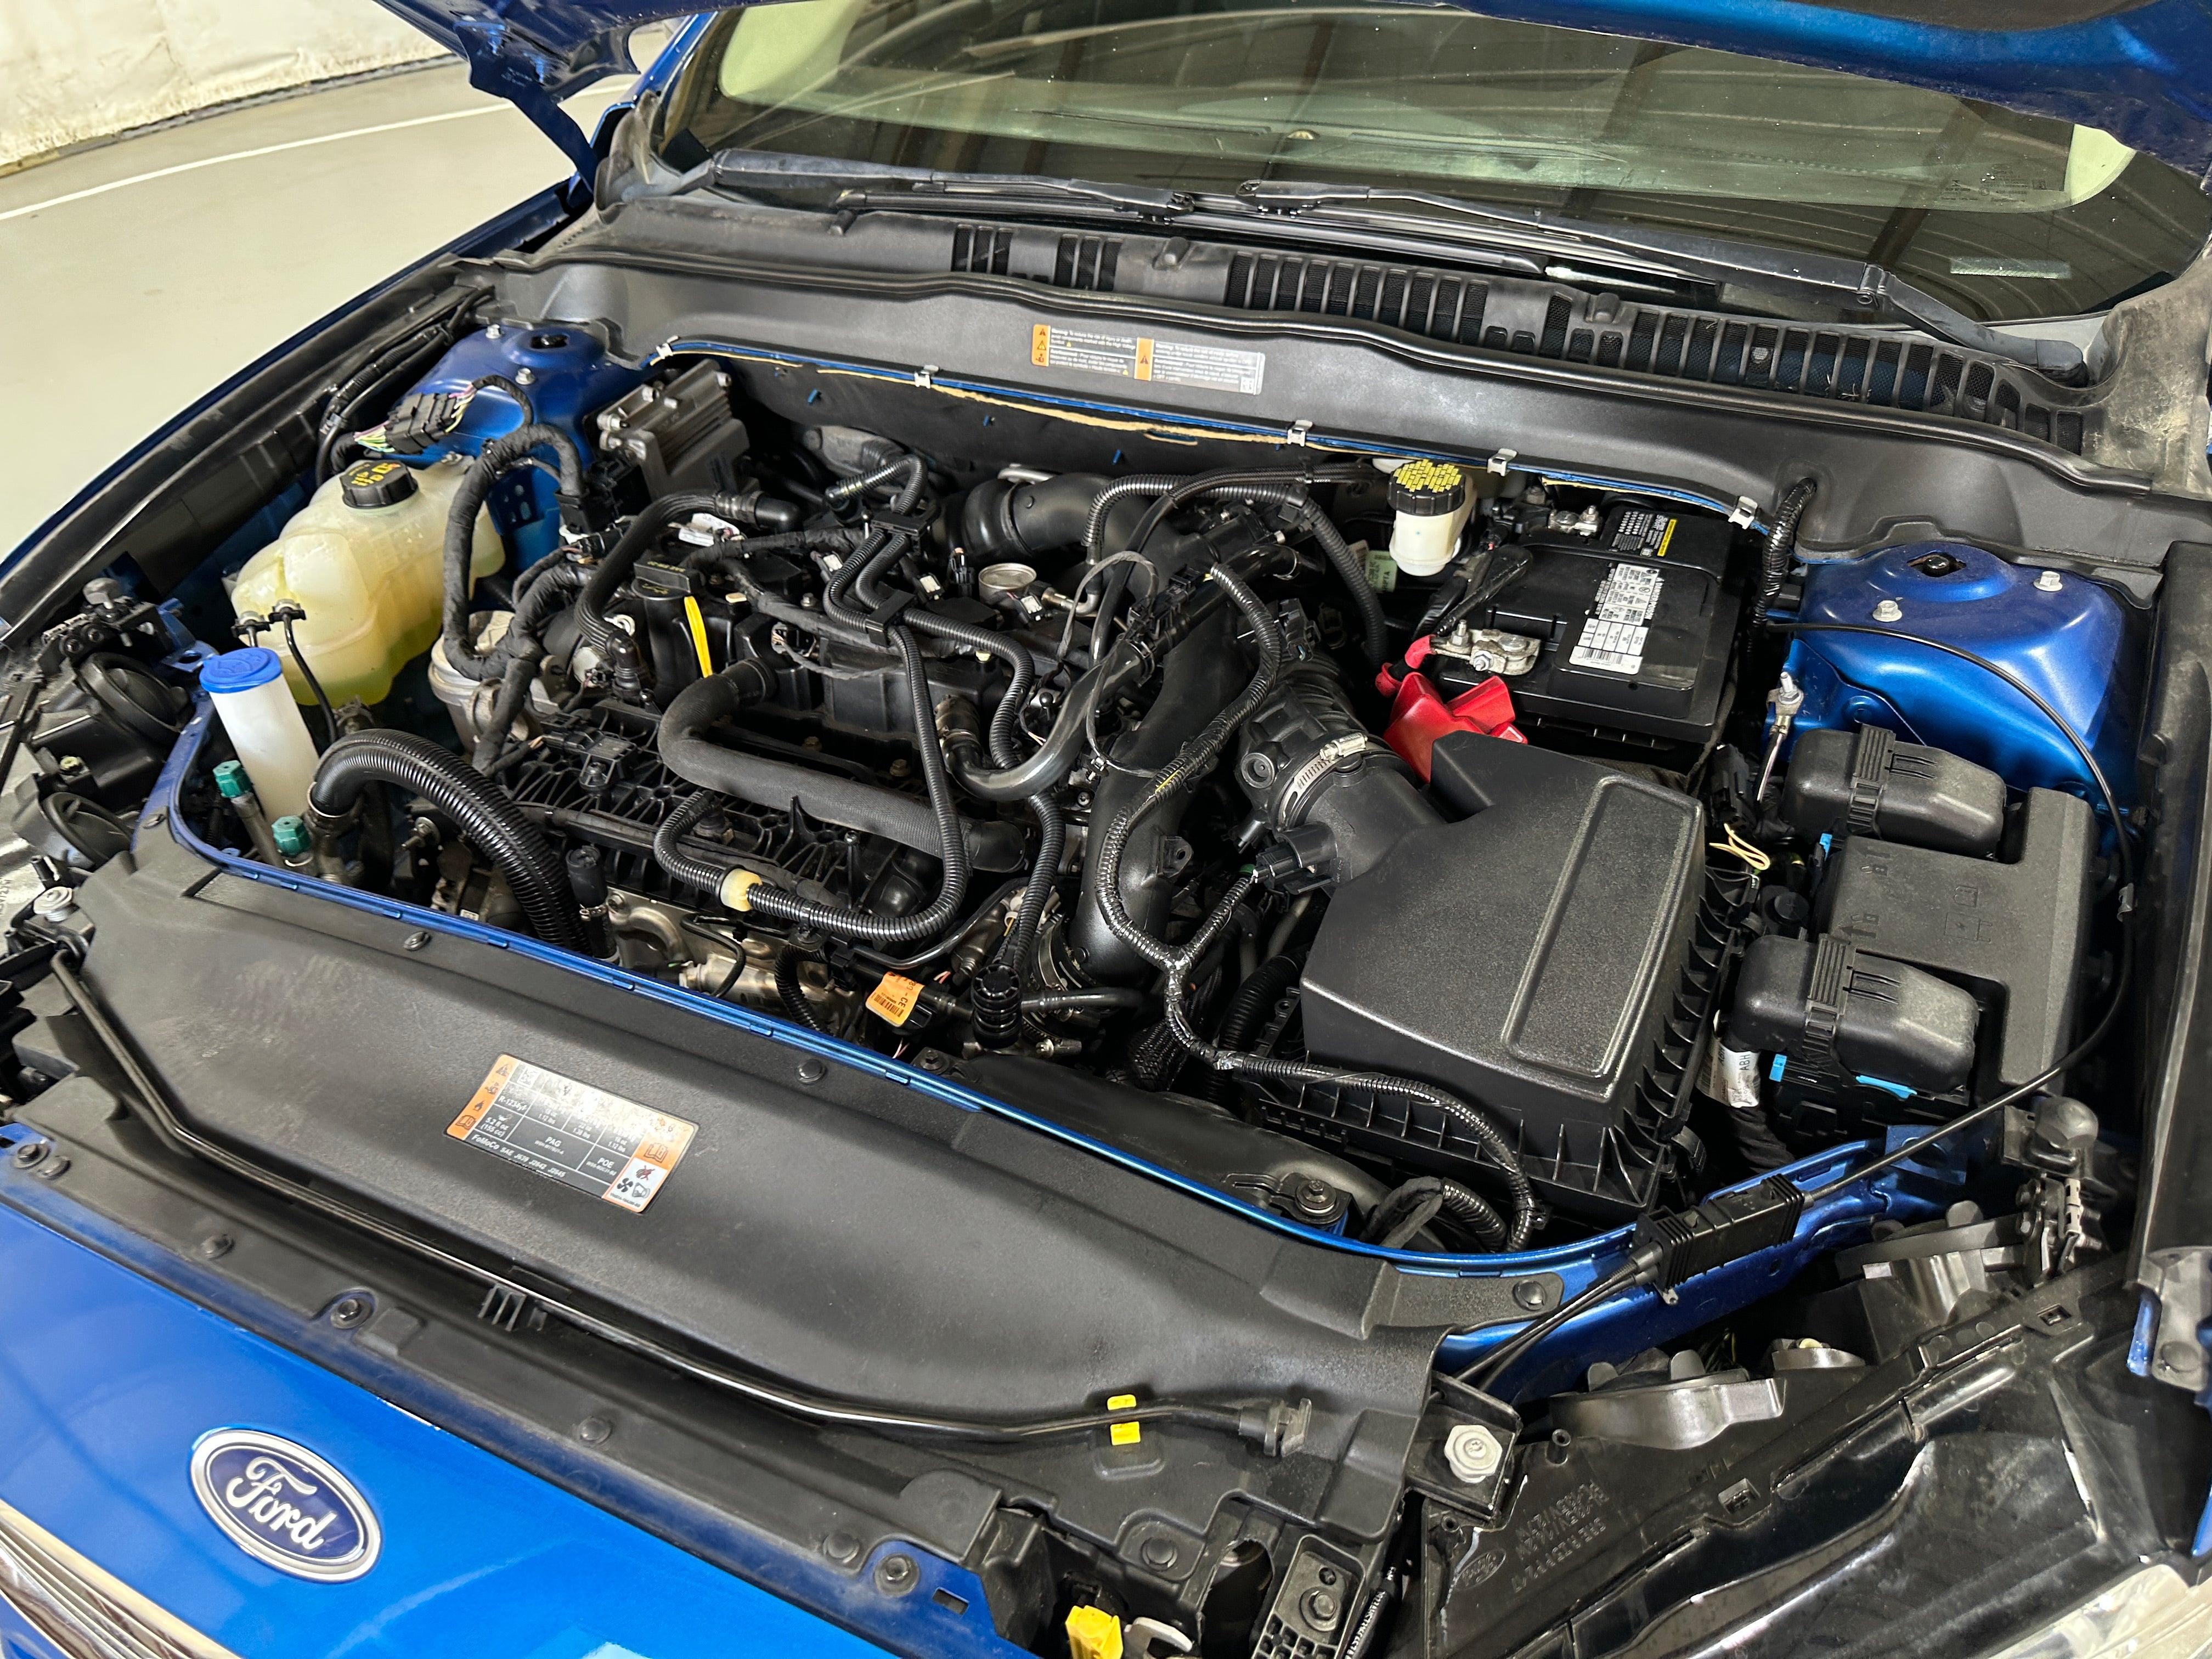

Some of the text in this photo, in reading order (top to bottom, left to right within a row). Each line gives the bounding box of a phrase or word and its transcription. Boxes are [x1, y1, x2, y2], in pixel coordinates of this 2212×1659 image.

[1739, 1053, 1751, 1071] ABH
[485, 1116, 496, 1125] 5.2
[480, 1121, 506, 1138] (155 cc)
[471, 1133, 500, 1149] FoMoCo
[500, 1146, 515, 1156] SAE
[545, 1136, 562, 1148] PAG
[597, 1155, 614, 1170] POE
[225, 1457, 337, 1550] Ford
[1577, 1516, 1606, 1543] SAE
